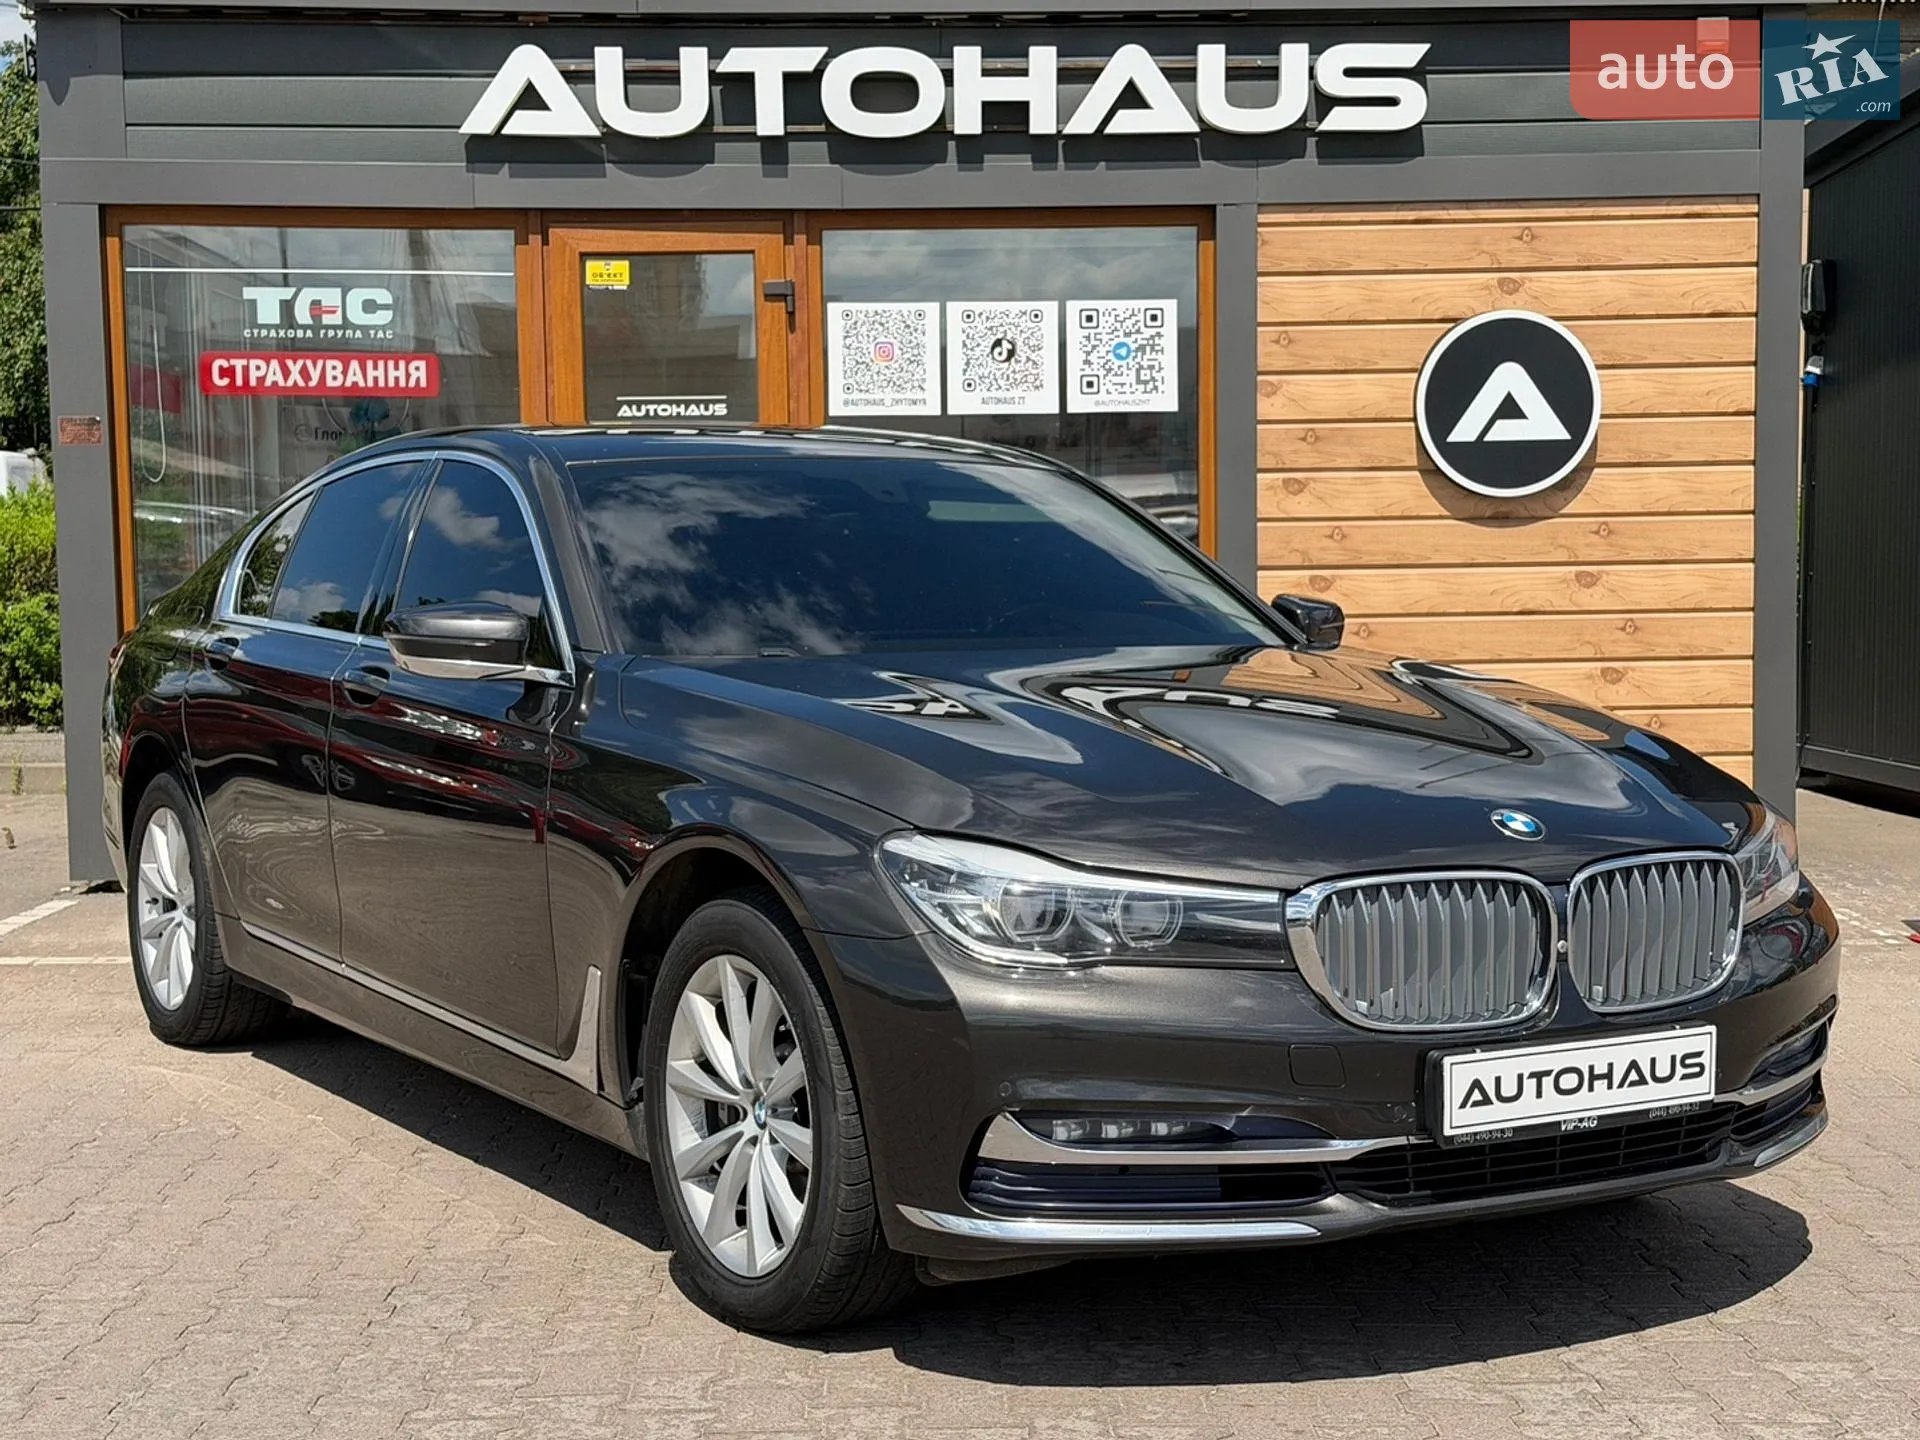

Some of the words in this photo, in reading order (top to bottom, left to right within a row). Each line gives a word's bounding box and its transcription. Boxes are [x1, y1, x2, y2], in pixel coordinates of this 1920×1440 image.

[459, 42, 1431, 139] AUTOHAUS
[243, 329, 313, 339] СТРАХОВА
[320, 329, 363, 339] ГРУПА
[369, 330, 394, 339] ТАС
[211, 359, 427, 388] СТРАХУВАННЯ
[616, 403, 728, 417] AUTOHAUS
[981, 396, 1016, 405] AUTOHAUS
[1017, 396, 1026, 405] ZT
[1458, 1051, 1705, 1109] AUTOHAUS
